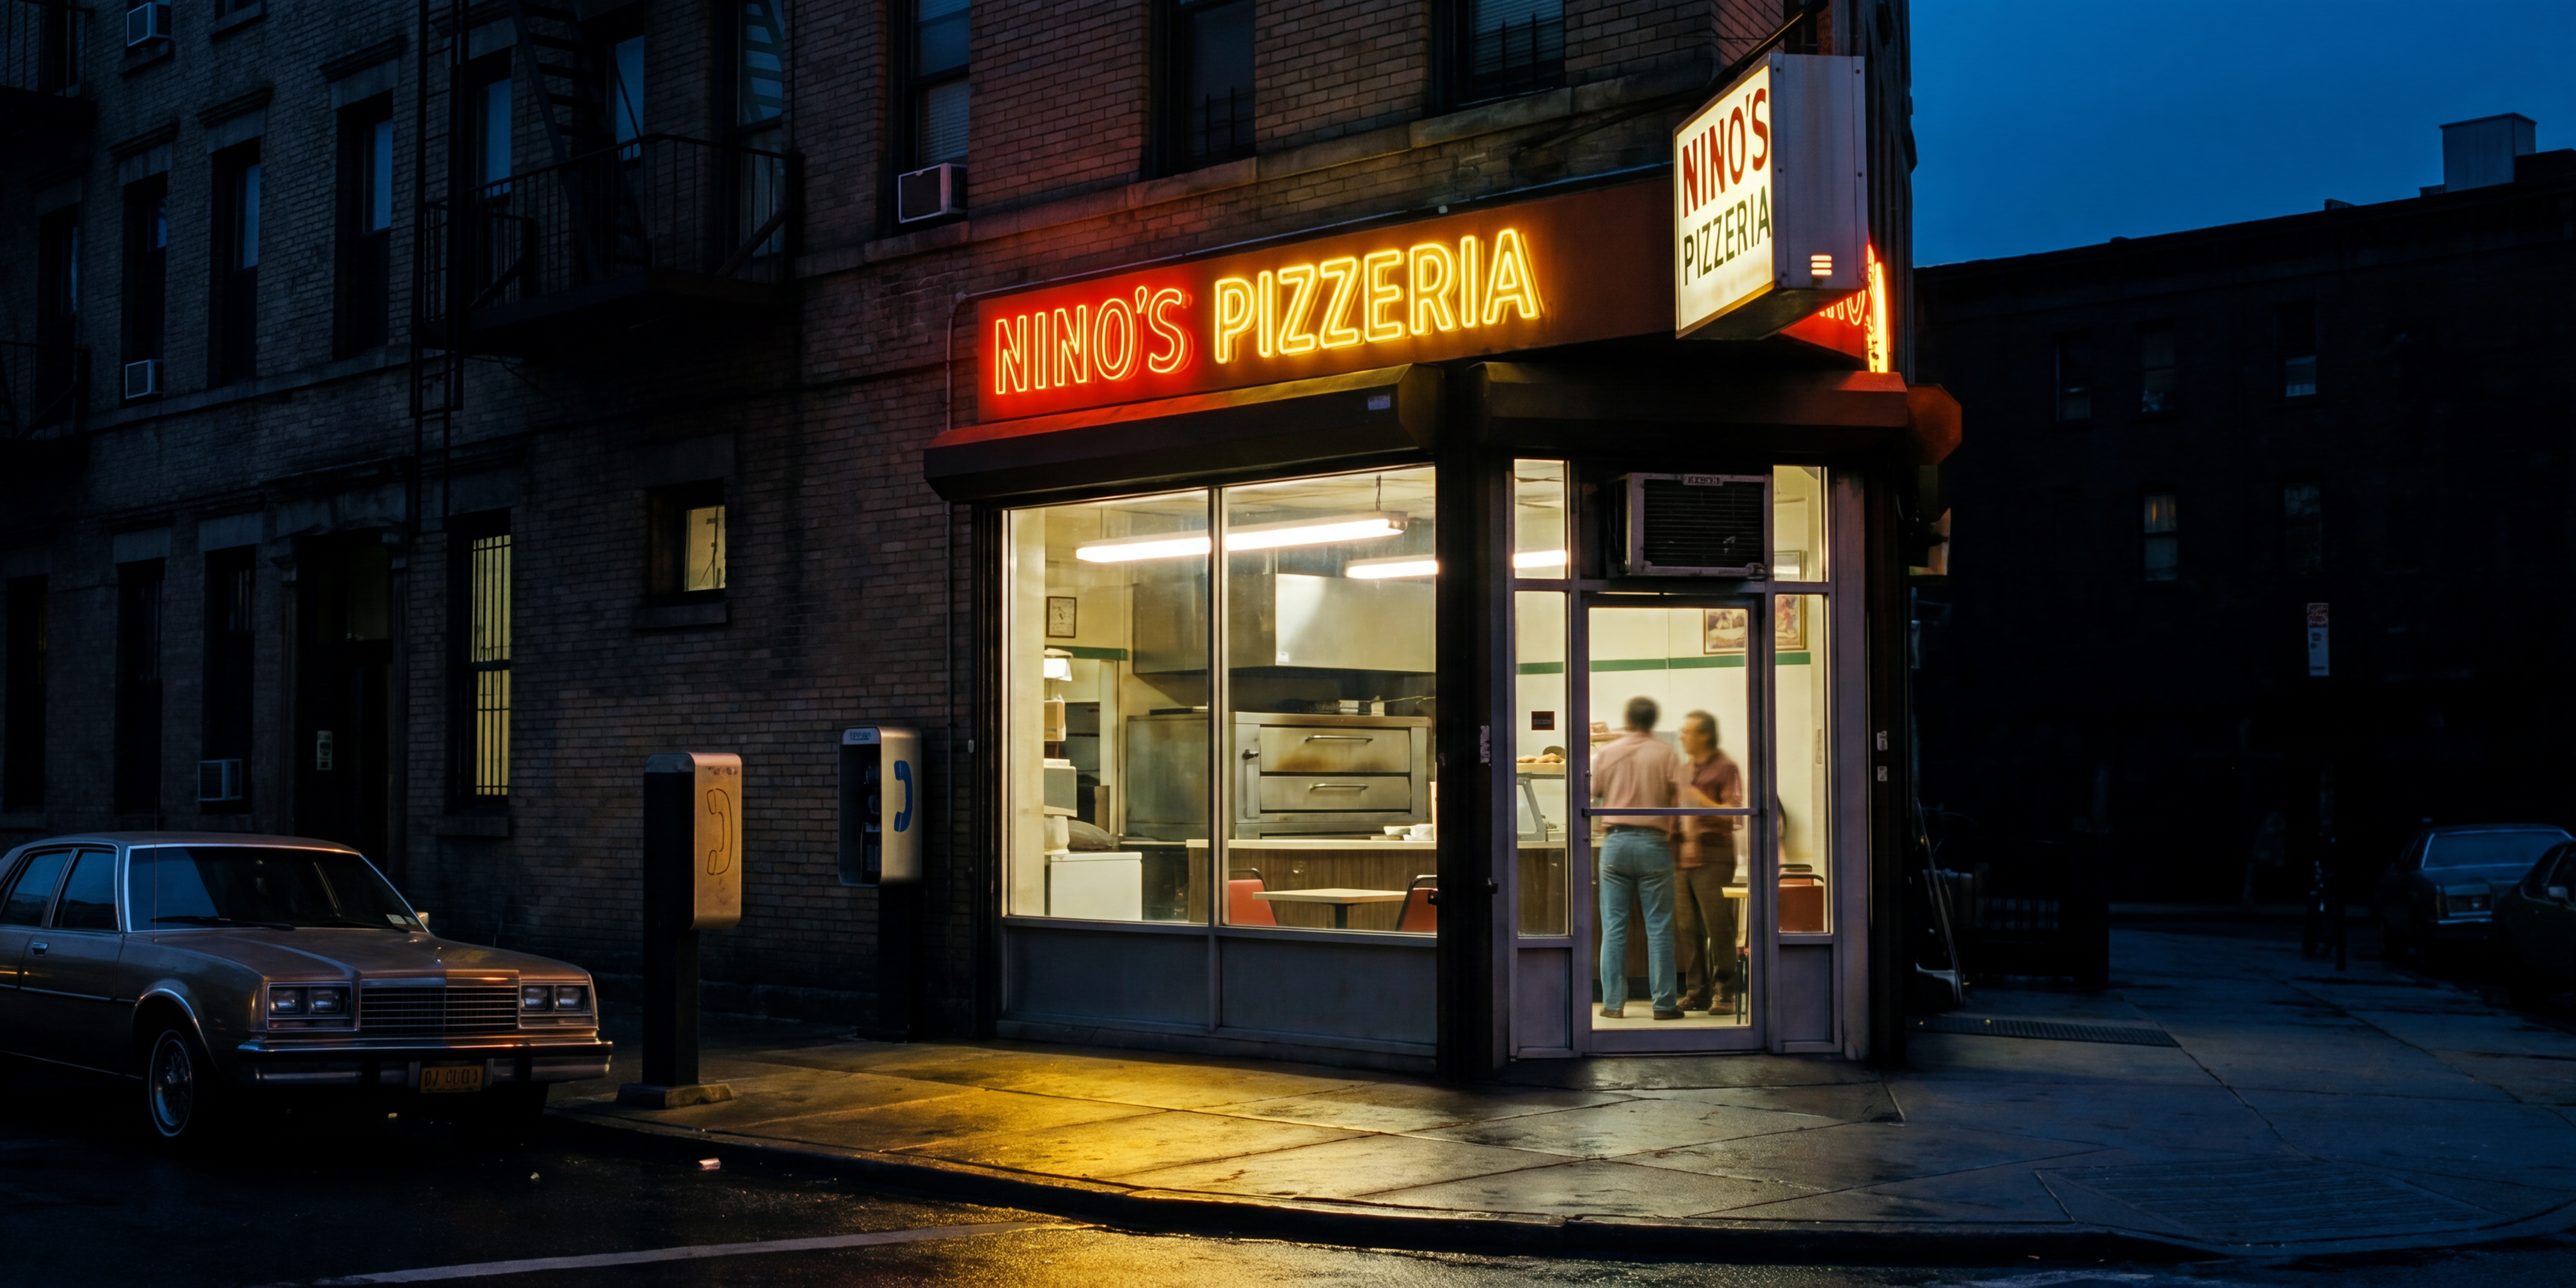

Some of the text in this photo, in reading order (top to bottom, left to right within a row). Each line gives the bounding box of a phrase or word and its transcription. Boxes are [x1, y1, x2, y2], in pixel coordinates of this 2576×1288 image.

[1682, 88, 1769, 218] NINO'S
[1684, 185, 1771, 286] PIZZERIA
[995, 228, 1538, 395] NINO'S PIZZERIA
